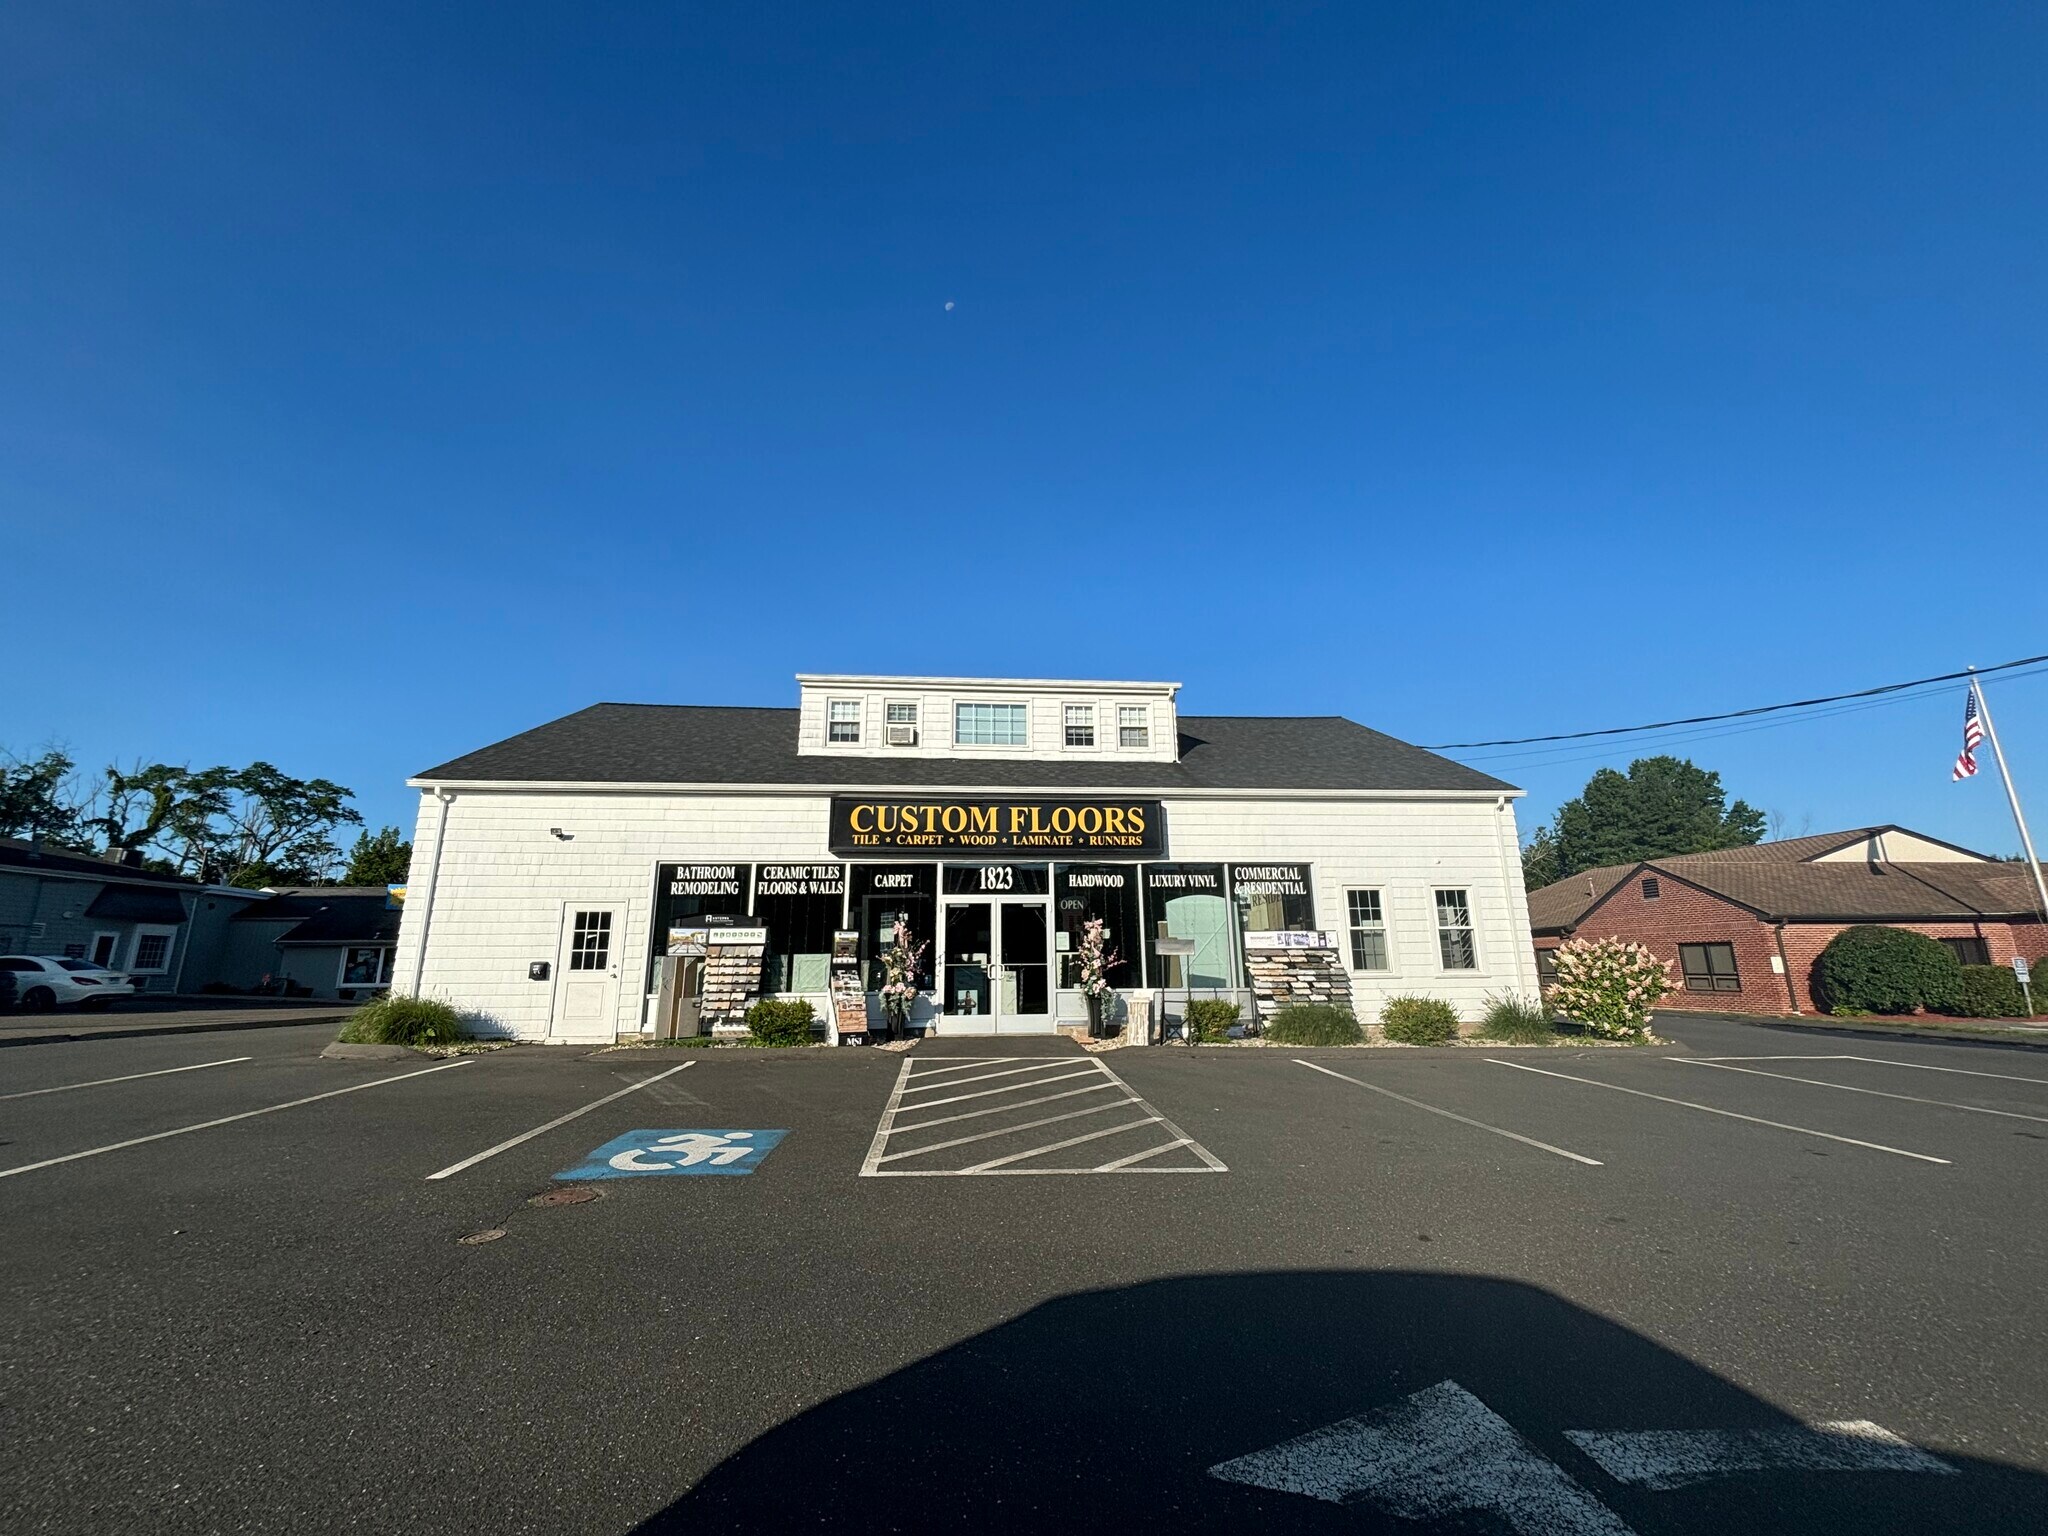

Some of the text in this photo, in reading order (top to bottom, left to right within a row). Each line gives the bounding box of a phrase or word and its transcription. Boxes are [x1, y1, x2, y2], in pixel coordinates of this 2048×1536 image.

[849, 804, 1146, 834] CUSTOM FLOORS
[852, 834, 1143, 846] TILE CARPET WOOD LAMINATE RUNNERS
[676, 866, 736, 880] BATHROOM
[763, 866, 841, 880] CERAMIC TILES
[979, 866, 1014, 890] 1823
[1234, 866, 1302, 881] COMMERCIAL
[670, 881, 740, 895] REMODELING
[757, 880, 844, 896] FLOORS & WALLS
[874, 874, 914, 888] CARPET
[1068, 874, 1125, 888] HARDWOOD
[1149, 874, 1218, 888] LUXURY VINYL
[1234, 881, 1307, 895] & RESIDENTIAL
[1060, 899, 1084, 910] OPEN
